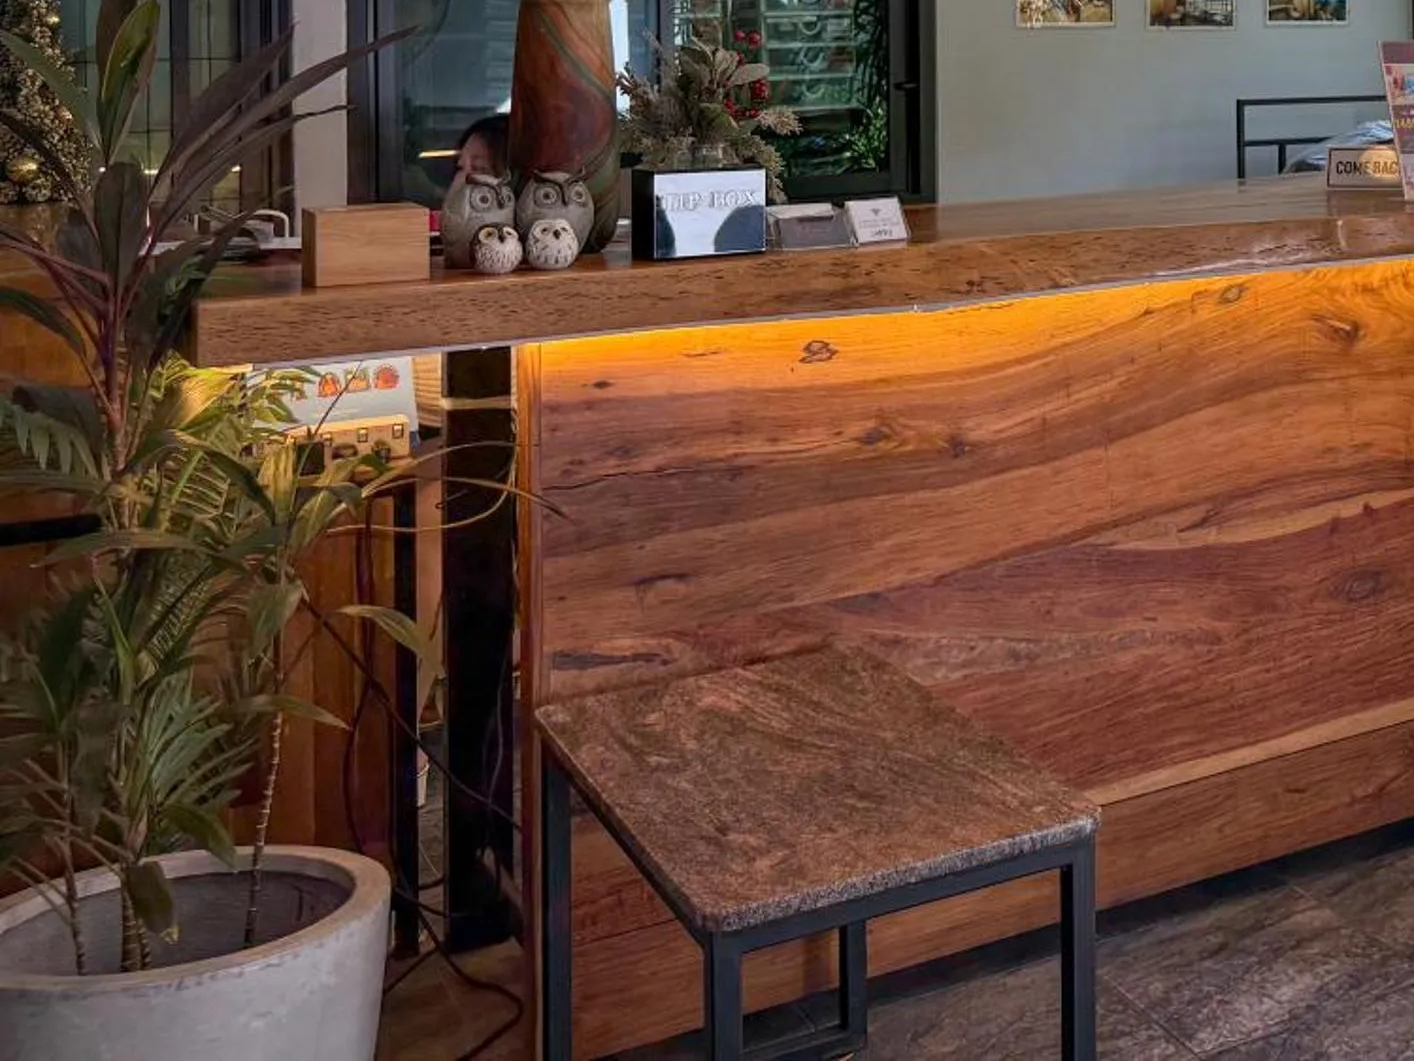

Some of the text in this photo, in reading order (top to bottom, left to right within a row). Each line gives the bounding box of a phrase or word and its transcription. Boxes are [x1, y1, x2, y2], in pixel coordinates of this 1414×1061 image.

[1336, 160, 1401, 176] COME BAC
[662, 189, 756, 211] TIP BOX
